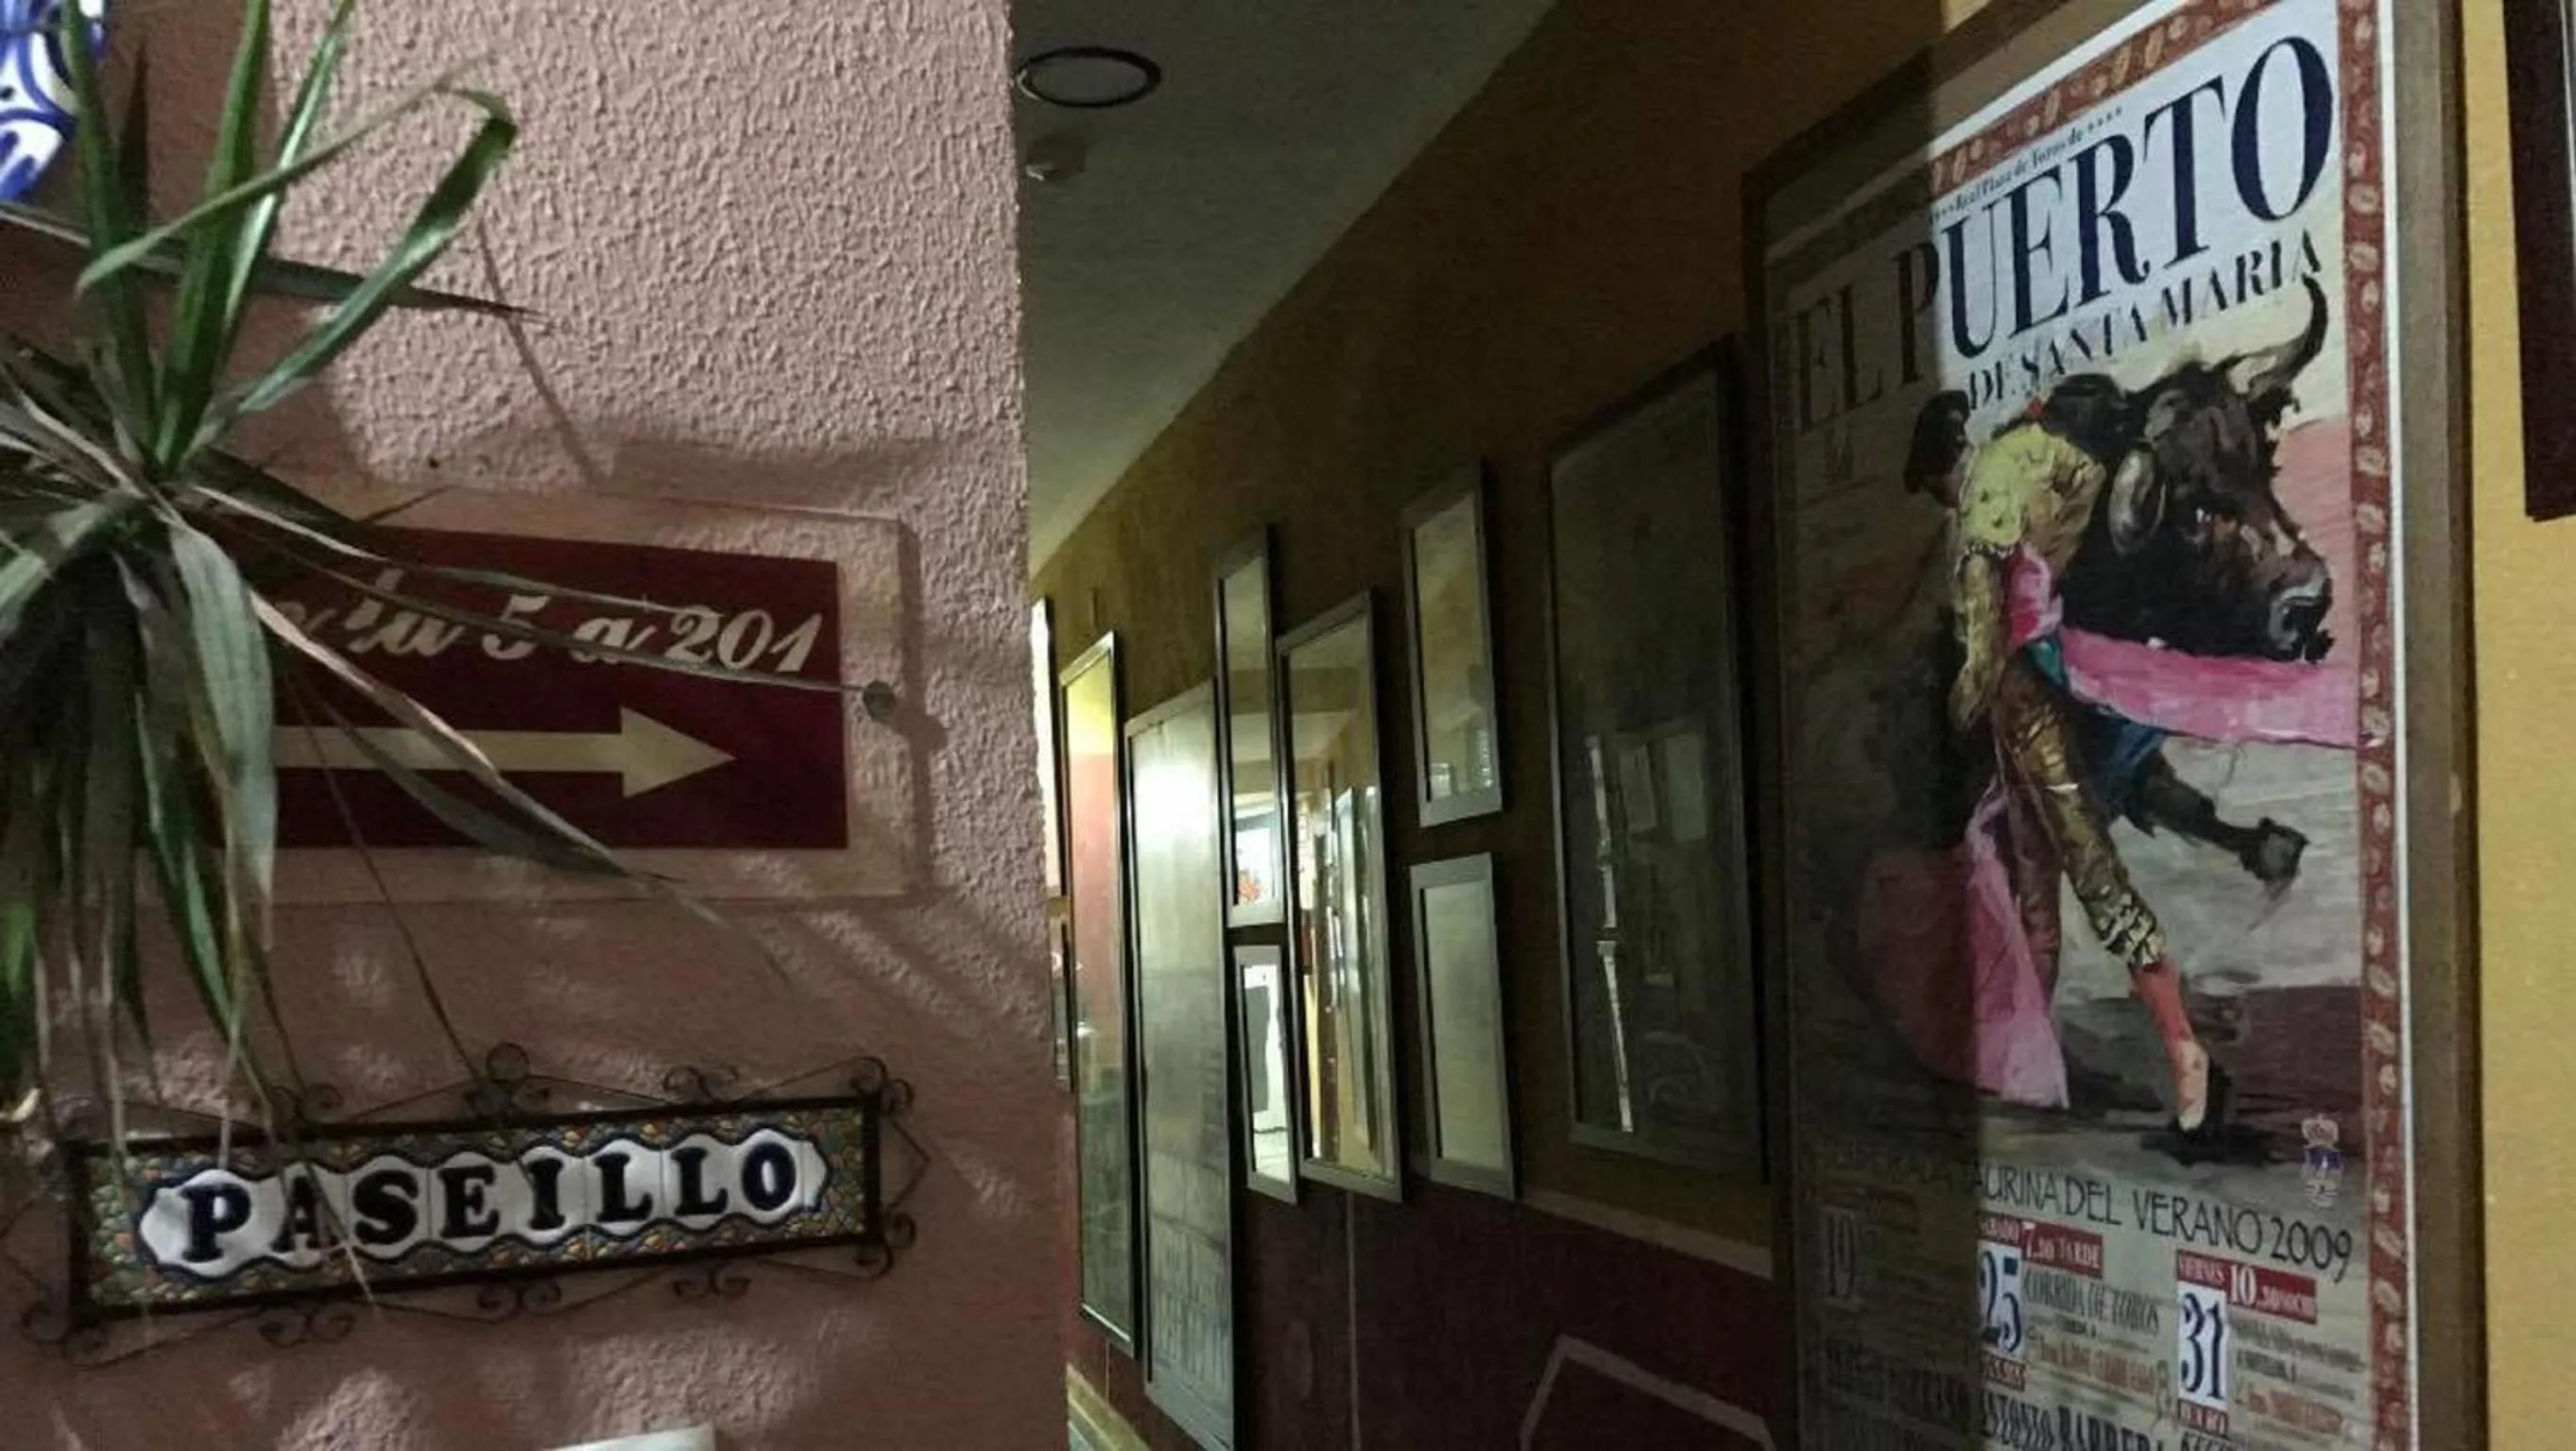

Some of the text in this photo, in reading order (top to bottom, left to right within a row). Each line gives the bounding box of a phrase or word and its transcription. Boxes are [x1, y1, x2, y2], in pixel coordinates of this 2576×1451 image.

[1797, 35, 2333, 436] EL PUERTO
[1966, 228, 2322, 410] DE SANTA MARIA
[480, 593, 550, 661] 5
[574, 610, 656, 663] a
[663, 605, 823, 674] 201
[180, 1140, 799, 1263] PASEILLO
[1950, 1154, 2064, 1215] AURINA
[2065, 1178, 2121, 1226] DEL
[2132, 1187, 2262, 1254] VERANO
[2270, 1217, 2353, 1285] 2009
[1979, 1249, 2022, 1354] 25
[2180, 1290, 2224, 1402] 31
